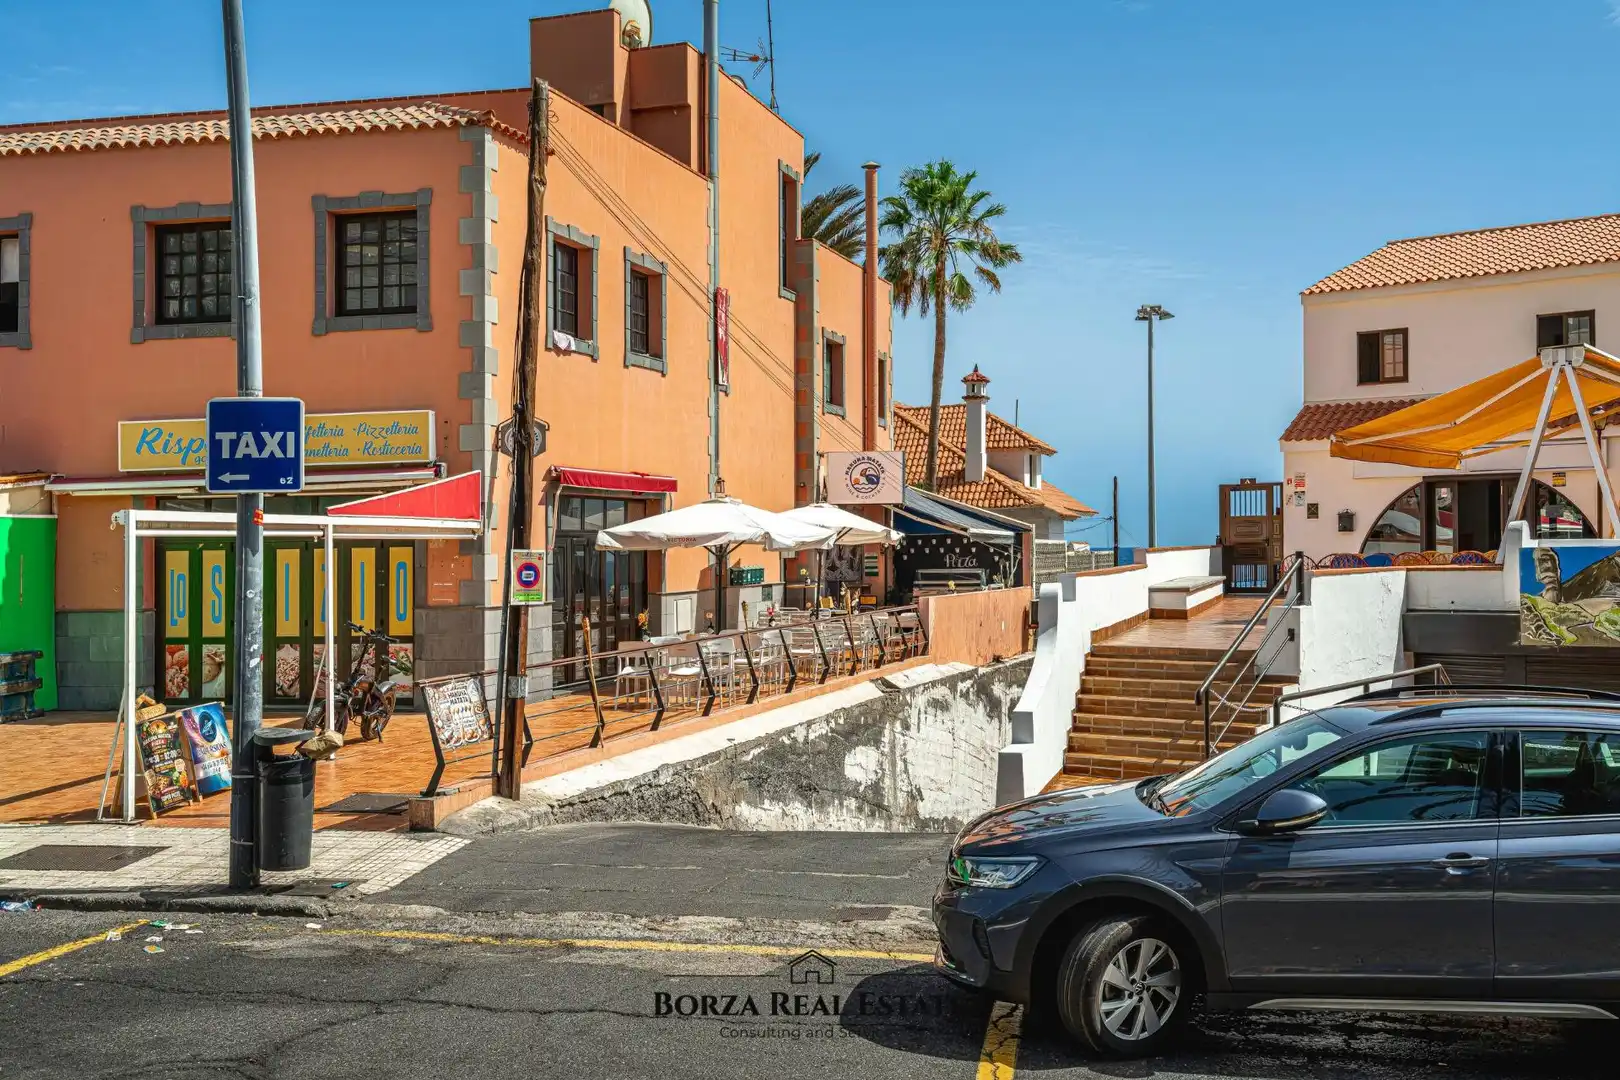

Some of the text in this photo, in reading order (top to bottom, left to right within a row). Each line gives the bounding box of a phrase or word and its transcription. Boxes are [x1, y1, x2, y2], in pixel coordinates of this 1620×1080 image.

[304, 420, 419, 444] fetteria Pizzetteria
[135, 427, 207, 466] Risp
[215, 431, 295, 459] TAXI
[362, 440, 423, 457] Rosticceria
[279, 476, 294, 485] 62
